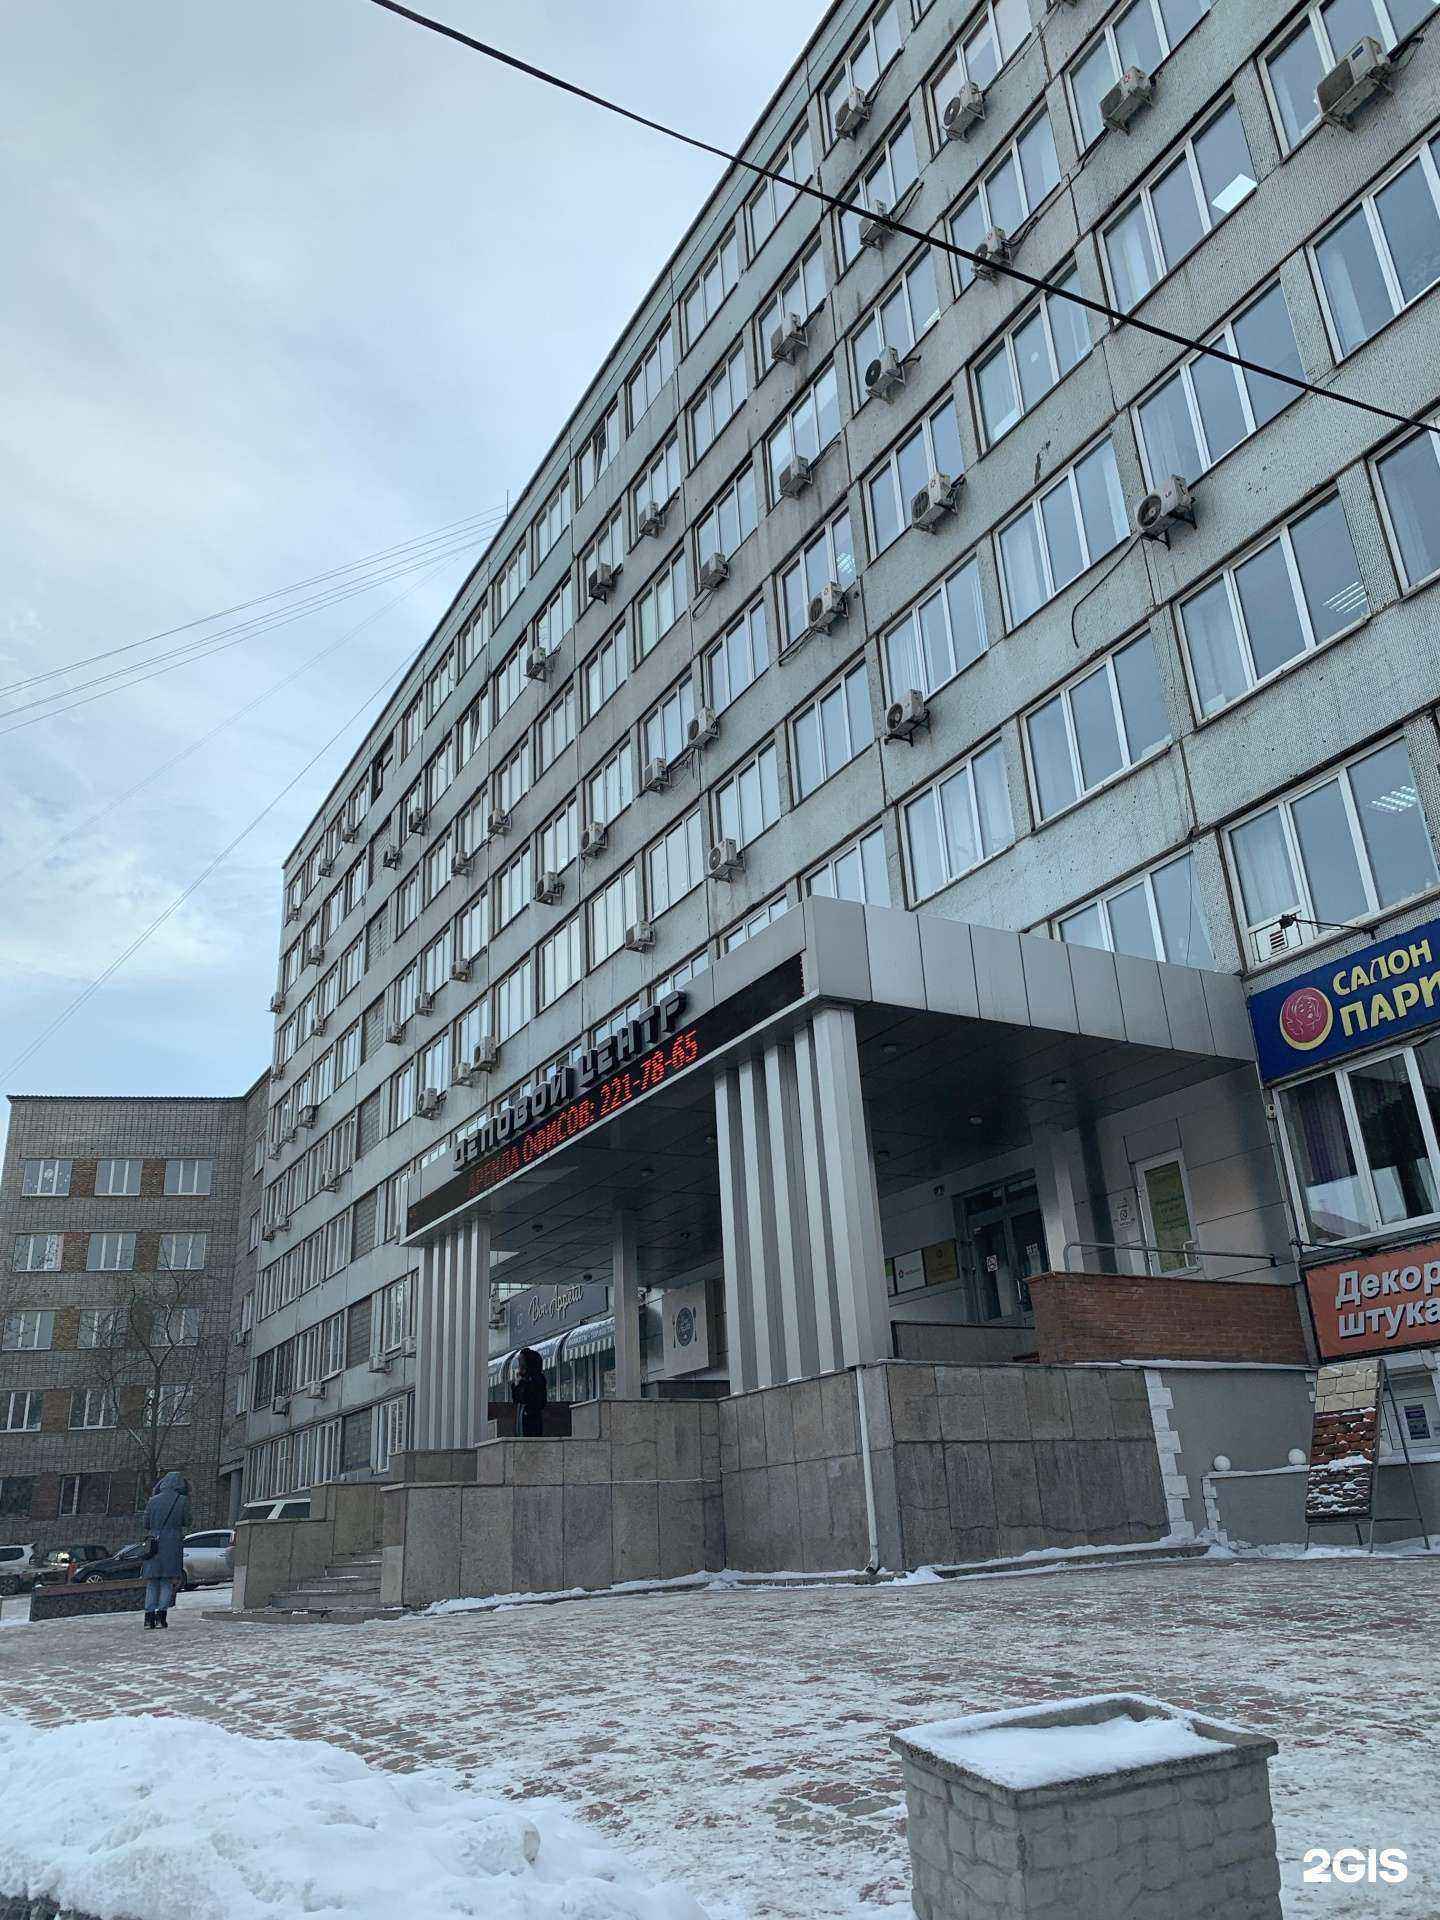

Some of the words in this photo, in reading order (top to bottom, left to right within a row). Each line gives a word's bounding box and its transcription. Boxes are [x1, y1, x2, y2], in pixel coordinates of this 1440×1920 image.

[1333, 939, 1433, 996] САЛОН
[453, 1065, 575, 1171] ДЕЛОВОЙ
[576, 989, 688, 1087] ЦЕНТР
[600, 1030, 699, 1116] 221-78-65
